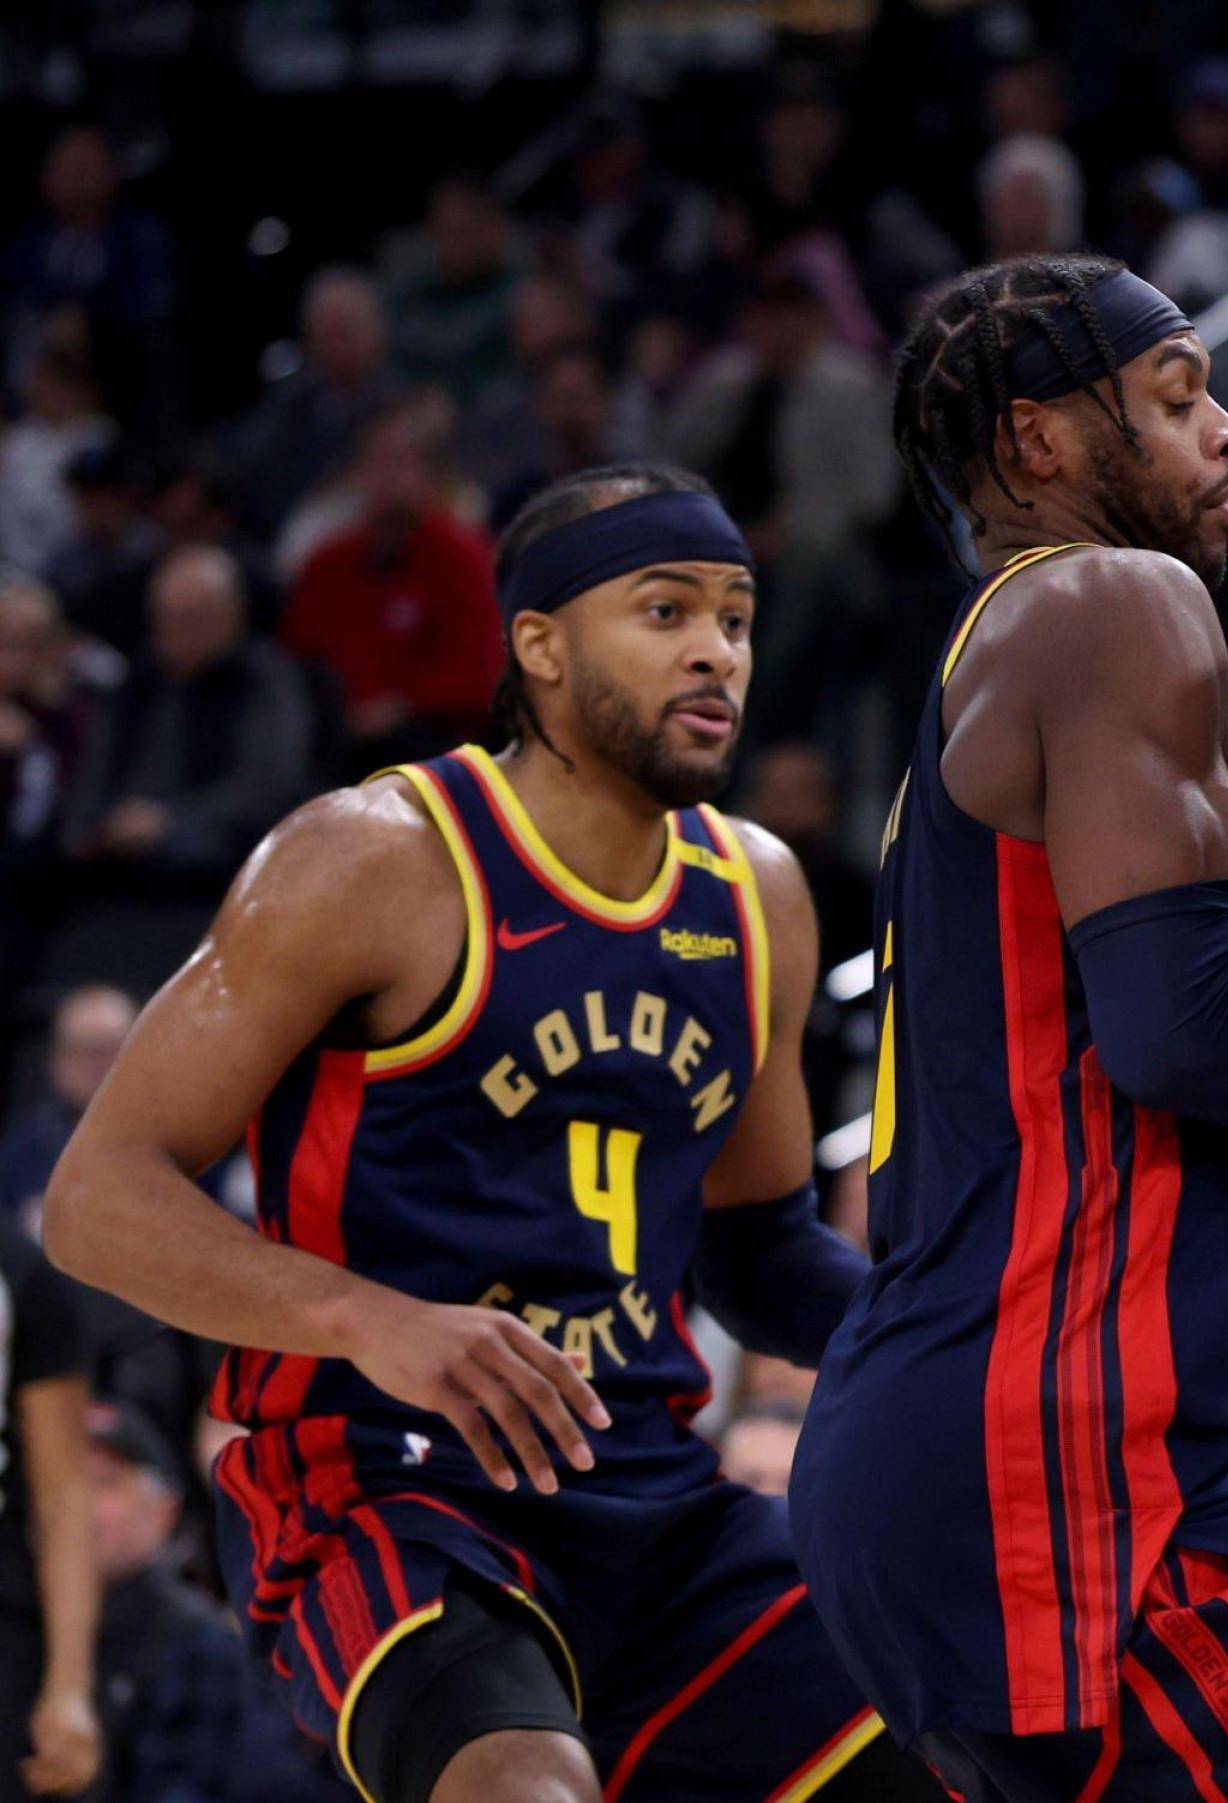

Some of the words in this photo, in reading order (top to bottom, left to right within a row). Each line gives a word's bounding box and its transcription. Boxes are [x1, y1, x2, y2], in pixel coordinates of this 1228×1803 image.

[660, 928, 737, 959] Rakuten
[480, 990, 736, 1132] GOLDEN
[568, 1120, 643, 1276] 4
